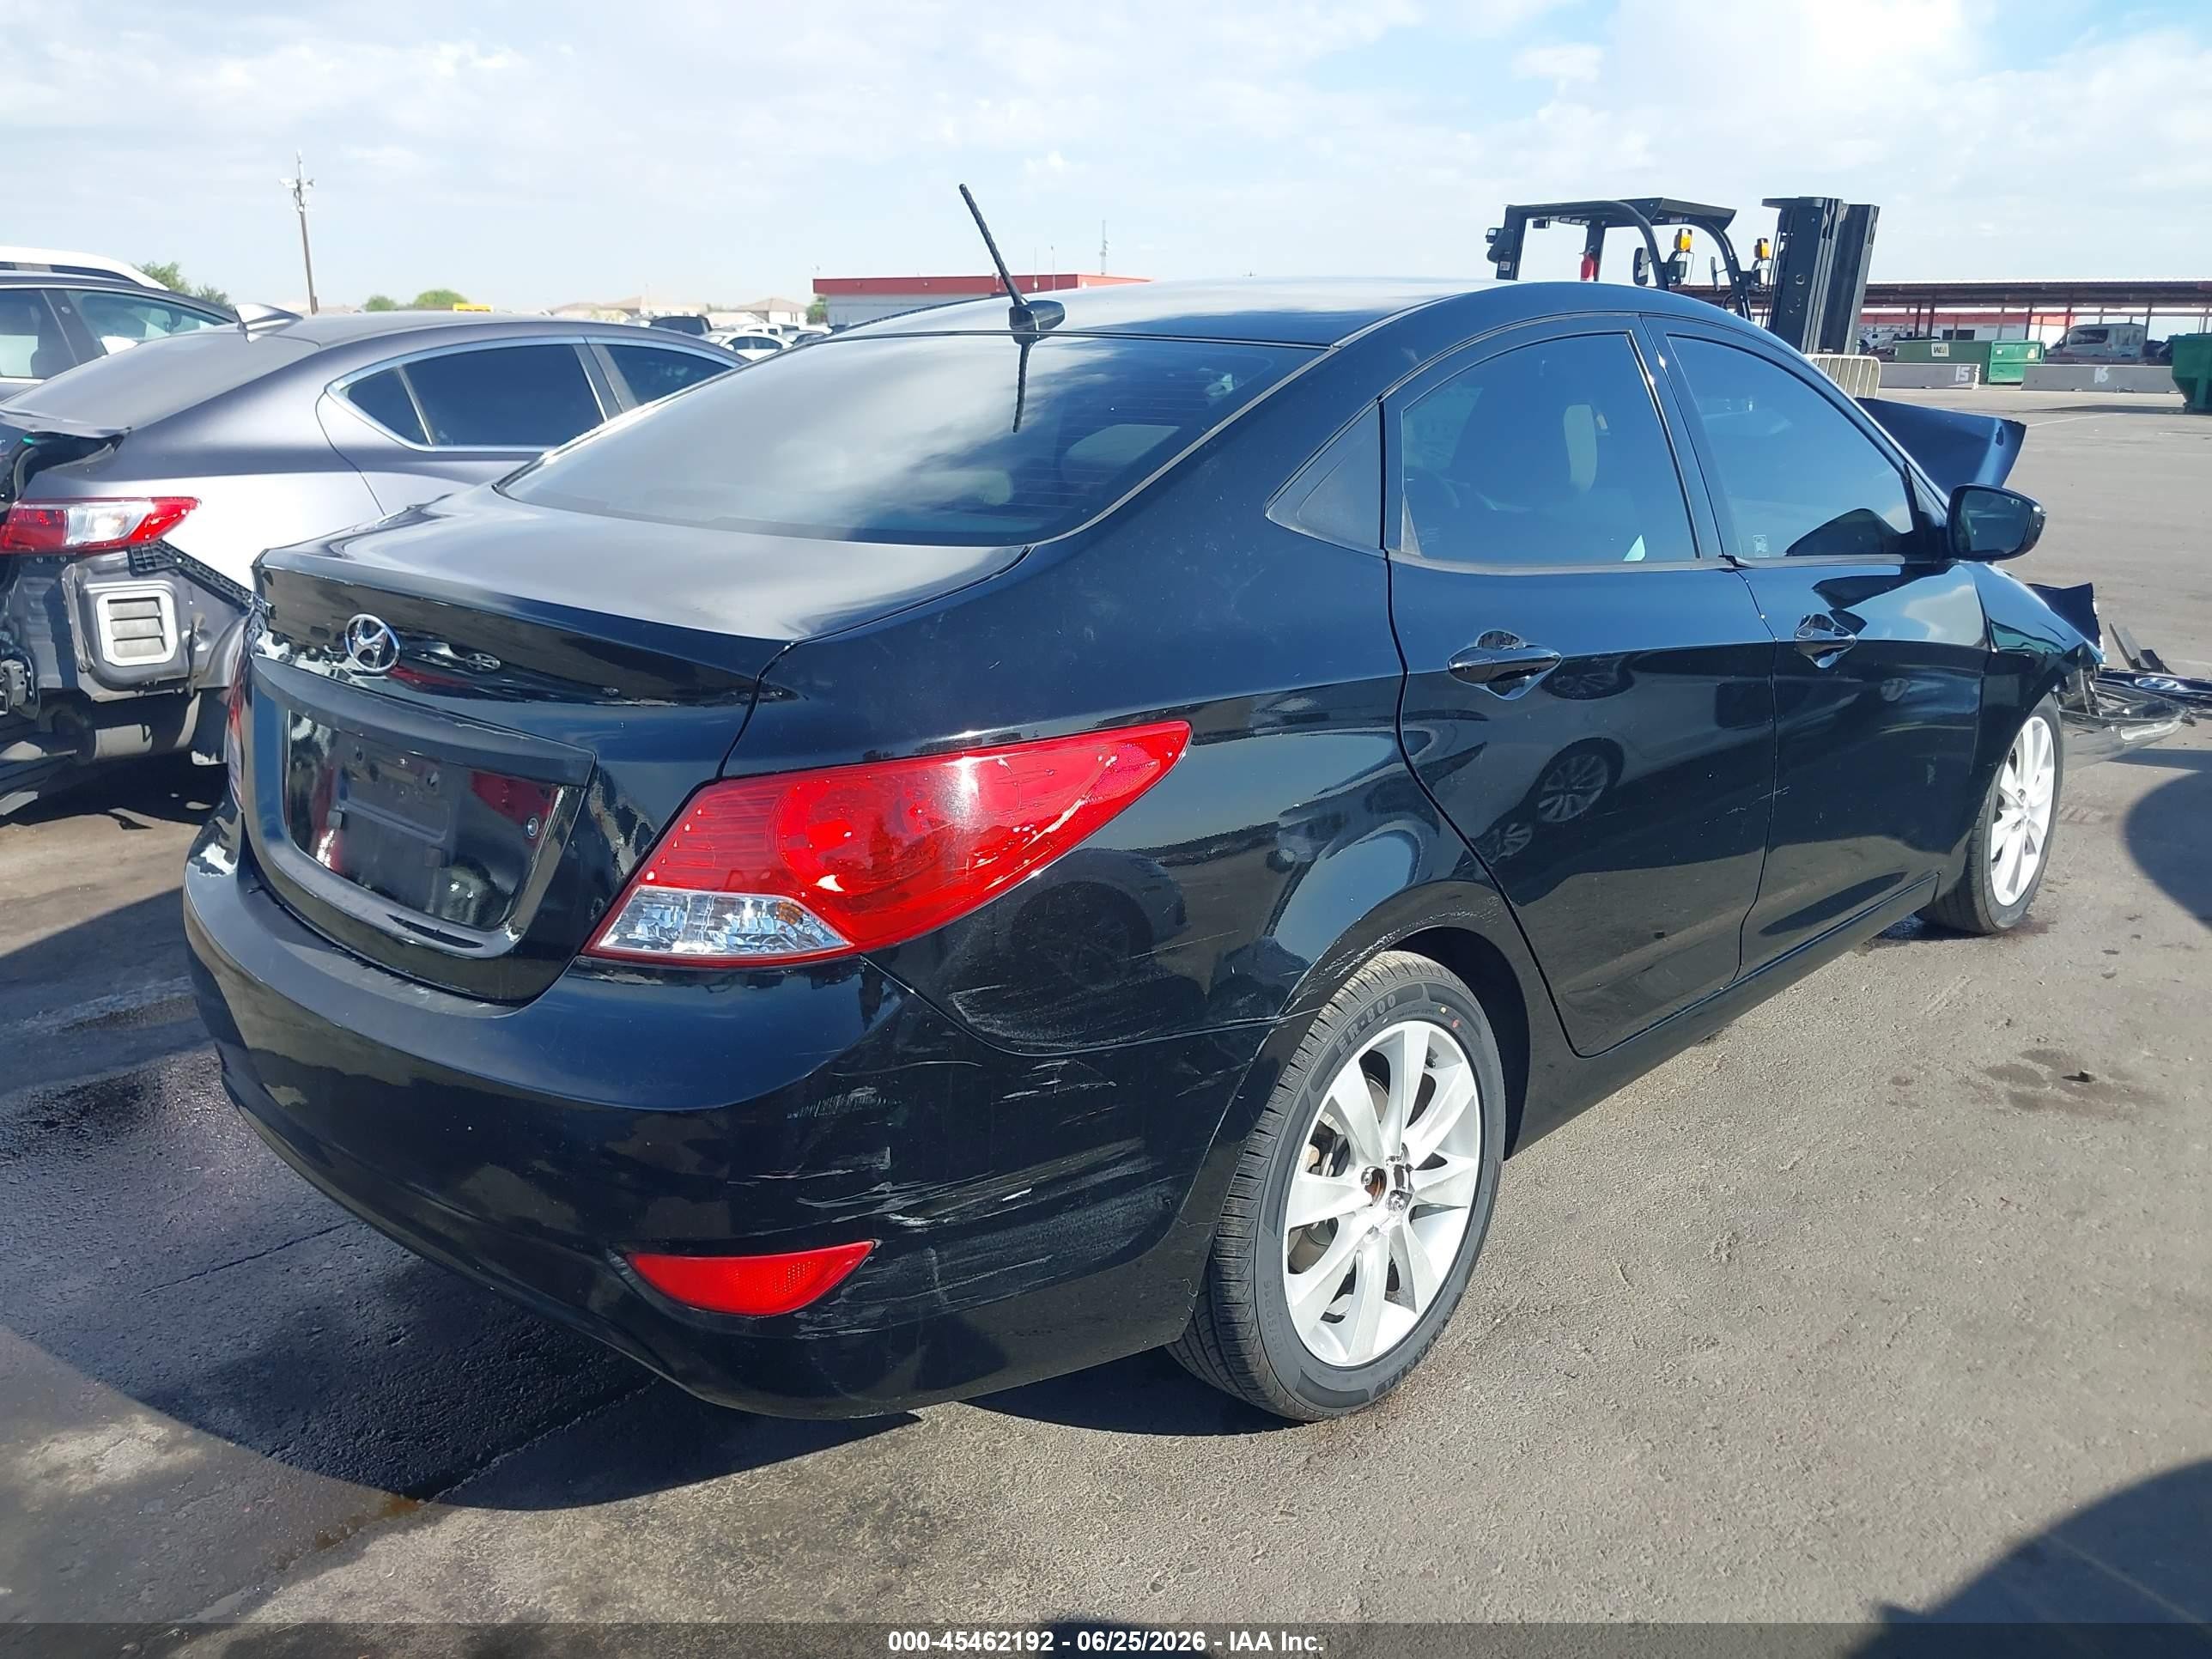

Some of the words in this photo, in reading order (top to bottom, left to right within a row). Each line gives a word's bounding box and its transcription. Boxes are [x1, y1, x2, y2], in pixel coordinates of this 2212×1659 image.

[1955, 366, 1971, 382] 15
[2094, 367, 2109, 384] 16
[1335, 994, 1396, 1054] ER-800
